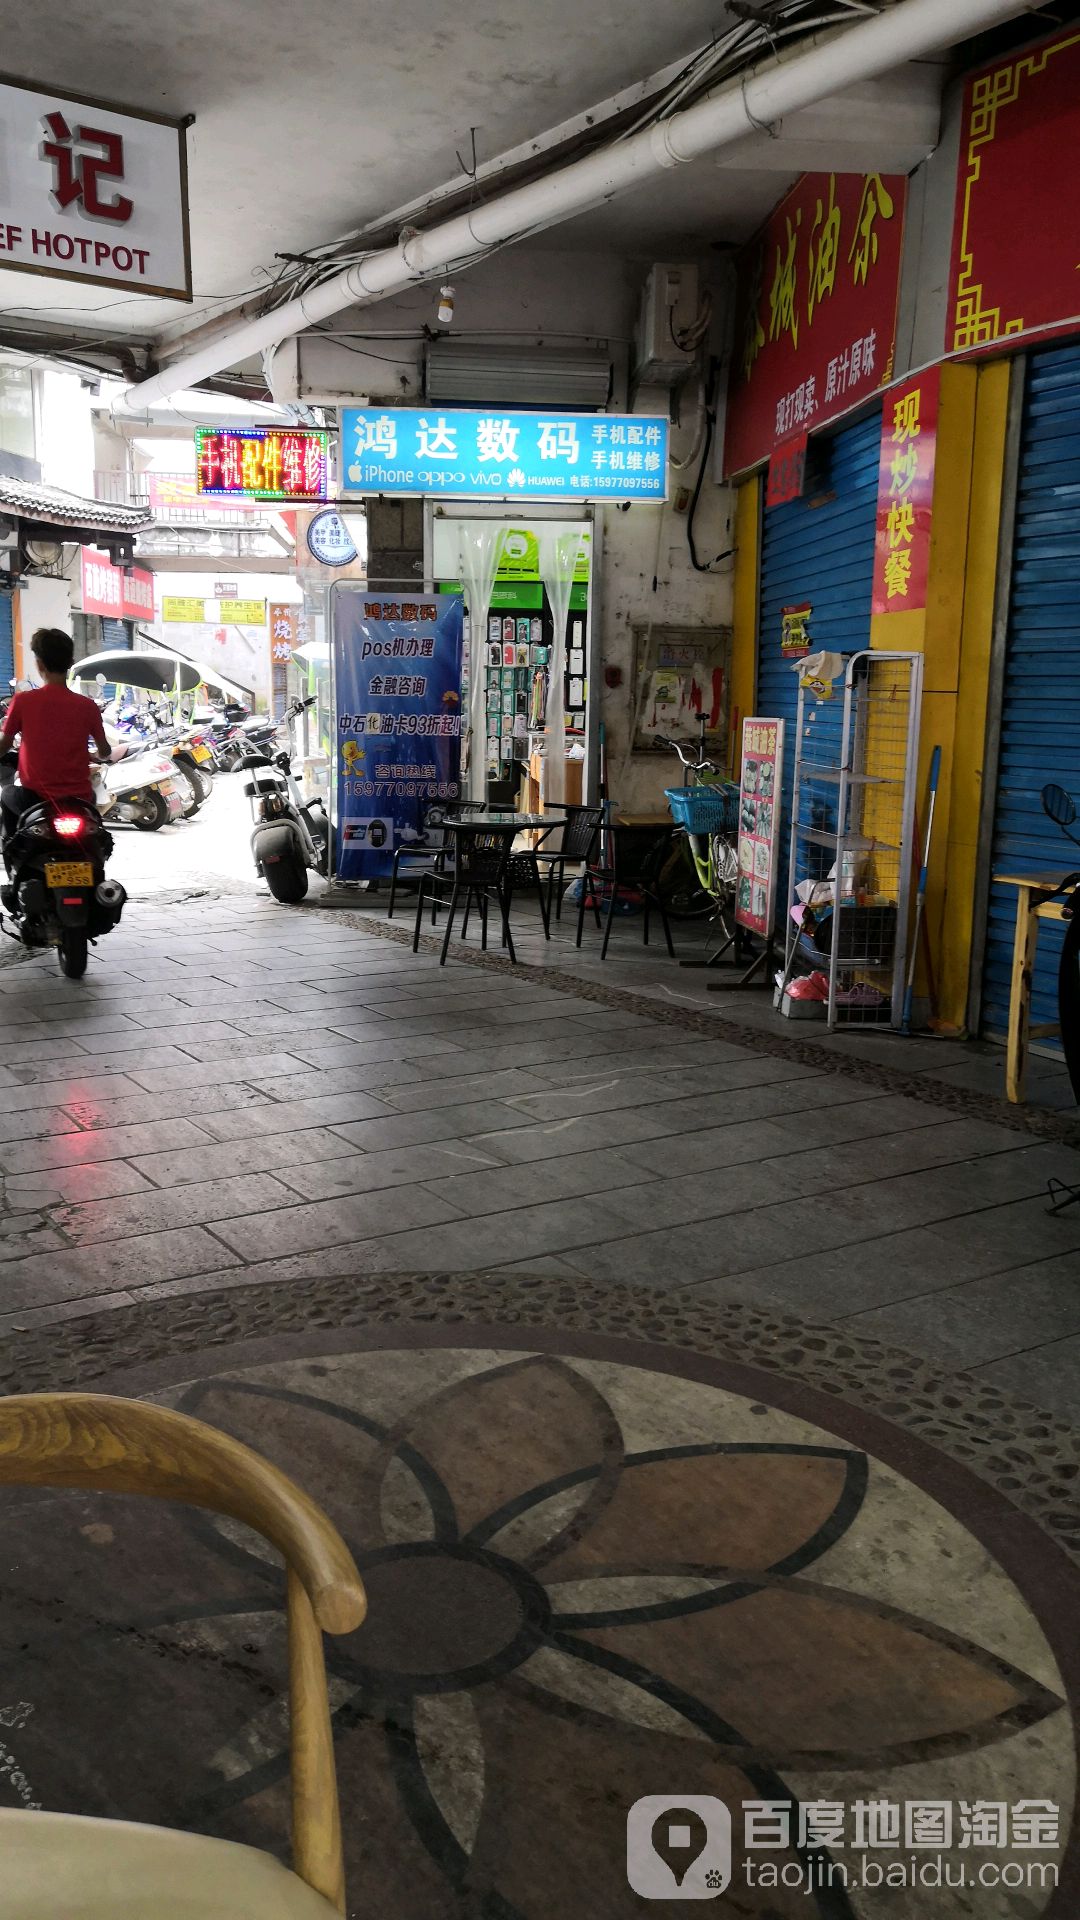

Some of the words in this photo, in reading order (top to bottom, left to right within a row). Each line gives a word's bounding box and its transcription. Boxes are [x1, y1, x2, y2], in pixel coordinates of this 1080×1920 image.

[39, 111, 134, 226] 记
[31, 228, 150, 274] HOTPOT
[354, 414, 580, 464] 鸿达数码
[591, 424, 662, 448] 手机配件
[199, 434, 321, 490] 手机配件维修
[591, 450, 661, 472] 手机维修
[365, 464, 413, 483] iPhone
[528, 475, 565, 486] HUAWEI
[883, 388, 921, 600] 现炒快餐
[363, 602, 438, 621] 鸿达数码
[272, 619, 293, 661] 烧烤
[361, 637, 435, 660] pos机办理
[368, 675, 427, 697] 金融咨询
[339, 713, 461, 736] 中石化油卡93折起!
[375, 764, 437, 779] 咨询热线
[343, 781, 459, 797] 15977097556
